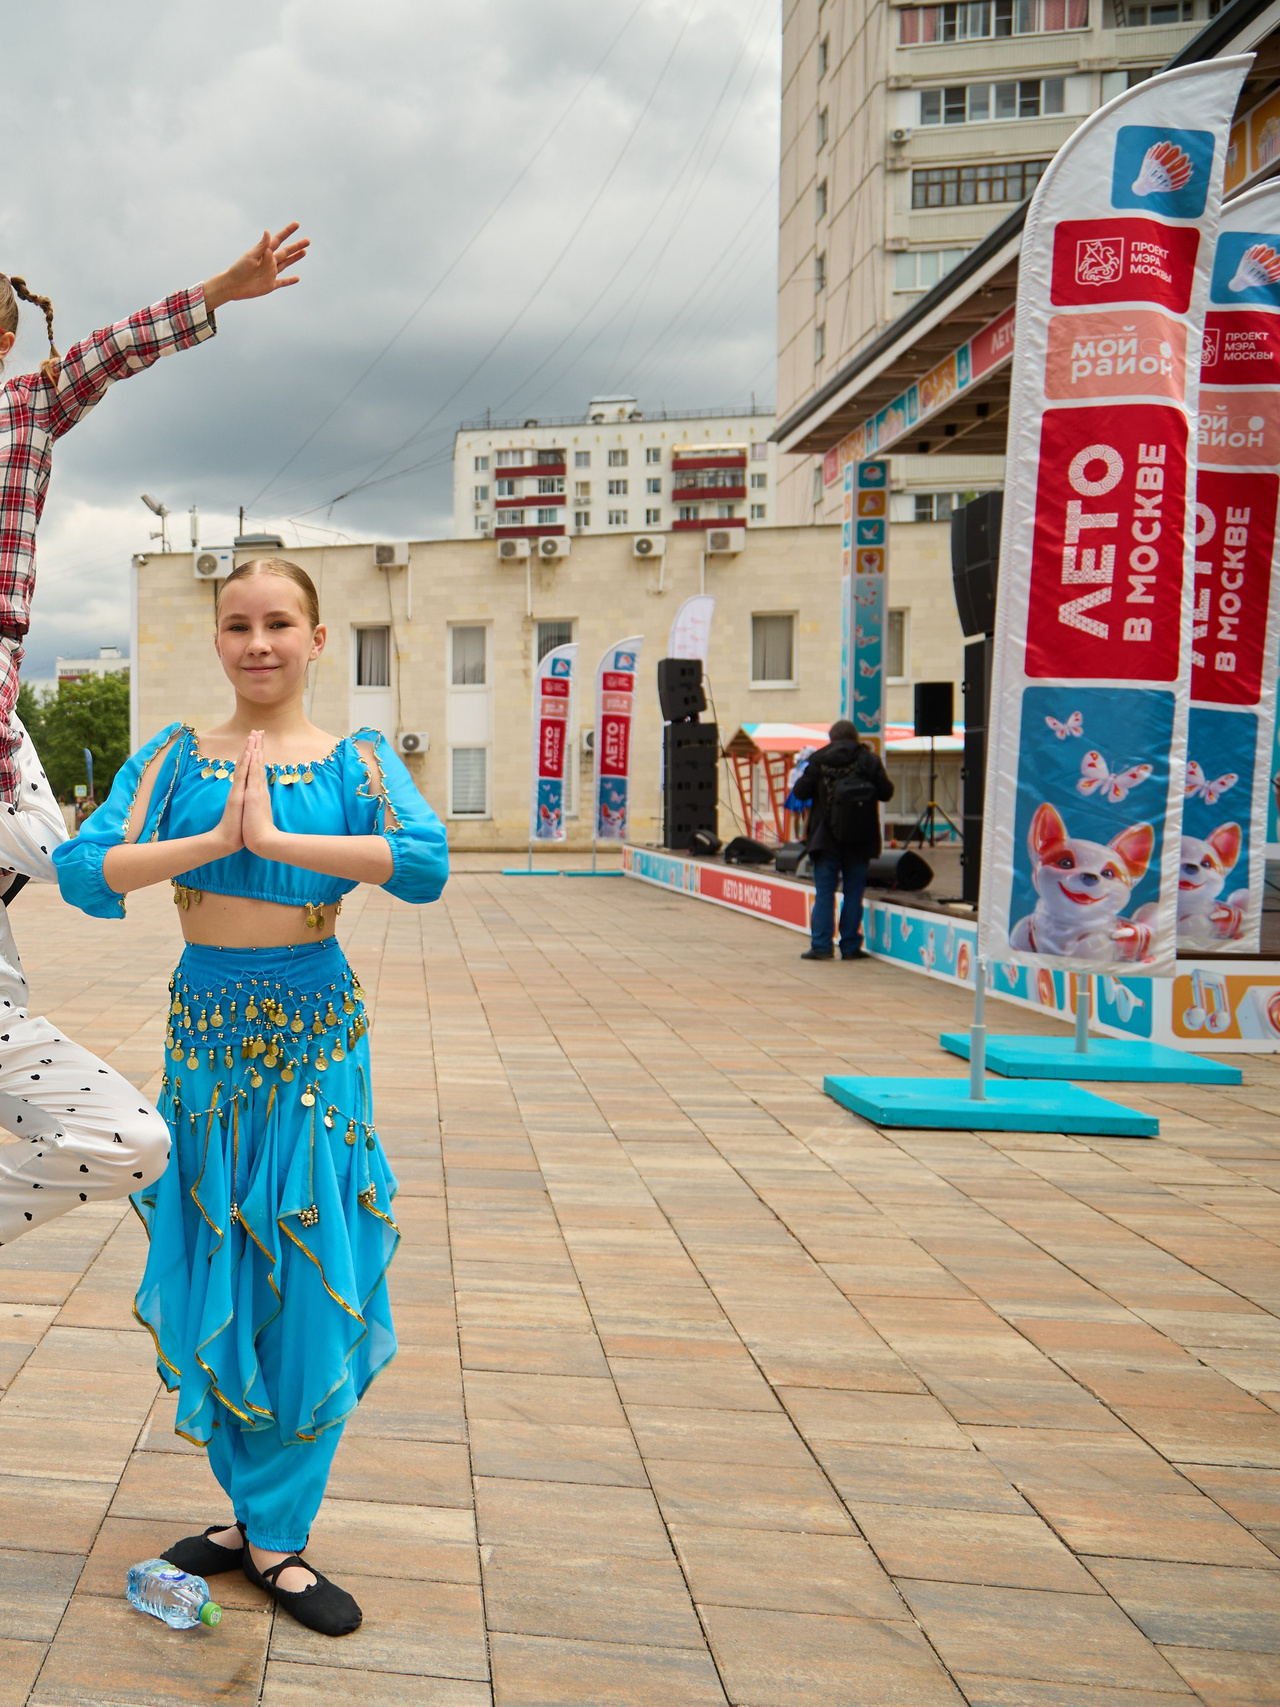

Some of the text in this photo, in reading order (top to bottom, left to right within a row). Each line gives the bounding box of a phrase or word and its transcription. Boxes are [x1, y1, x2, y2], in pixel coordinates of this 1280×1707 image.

[1130, 253, 1161, 267] МЭРА
[1131, 241, 1169, 260] ПРОЕКТ
[1130, 264, 1172, 284] МОСКВЫ
[1070, 325, 1138, 360] мой
[1224, 342, 1256, 351] МЭРА
[1225, 332, 1269, 342] ПРОЕКТ
[1223, 351, 1273, 361] МОСКВЫ
[1198, 405, 1228, 430] ой
[1058, 443, 1124, 640] ЛЕТО
[1123, 443, 1167, 641] В МОСКВЕ
[1215, 506, 1251, 672] В МОСКВЕ
[545, 727, 553, 769] ЛЕТО
[606, 722, 618, 767] ЛЕТО
